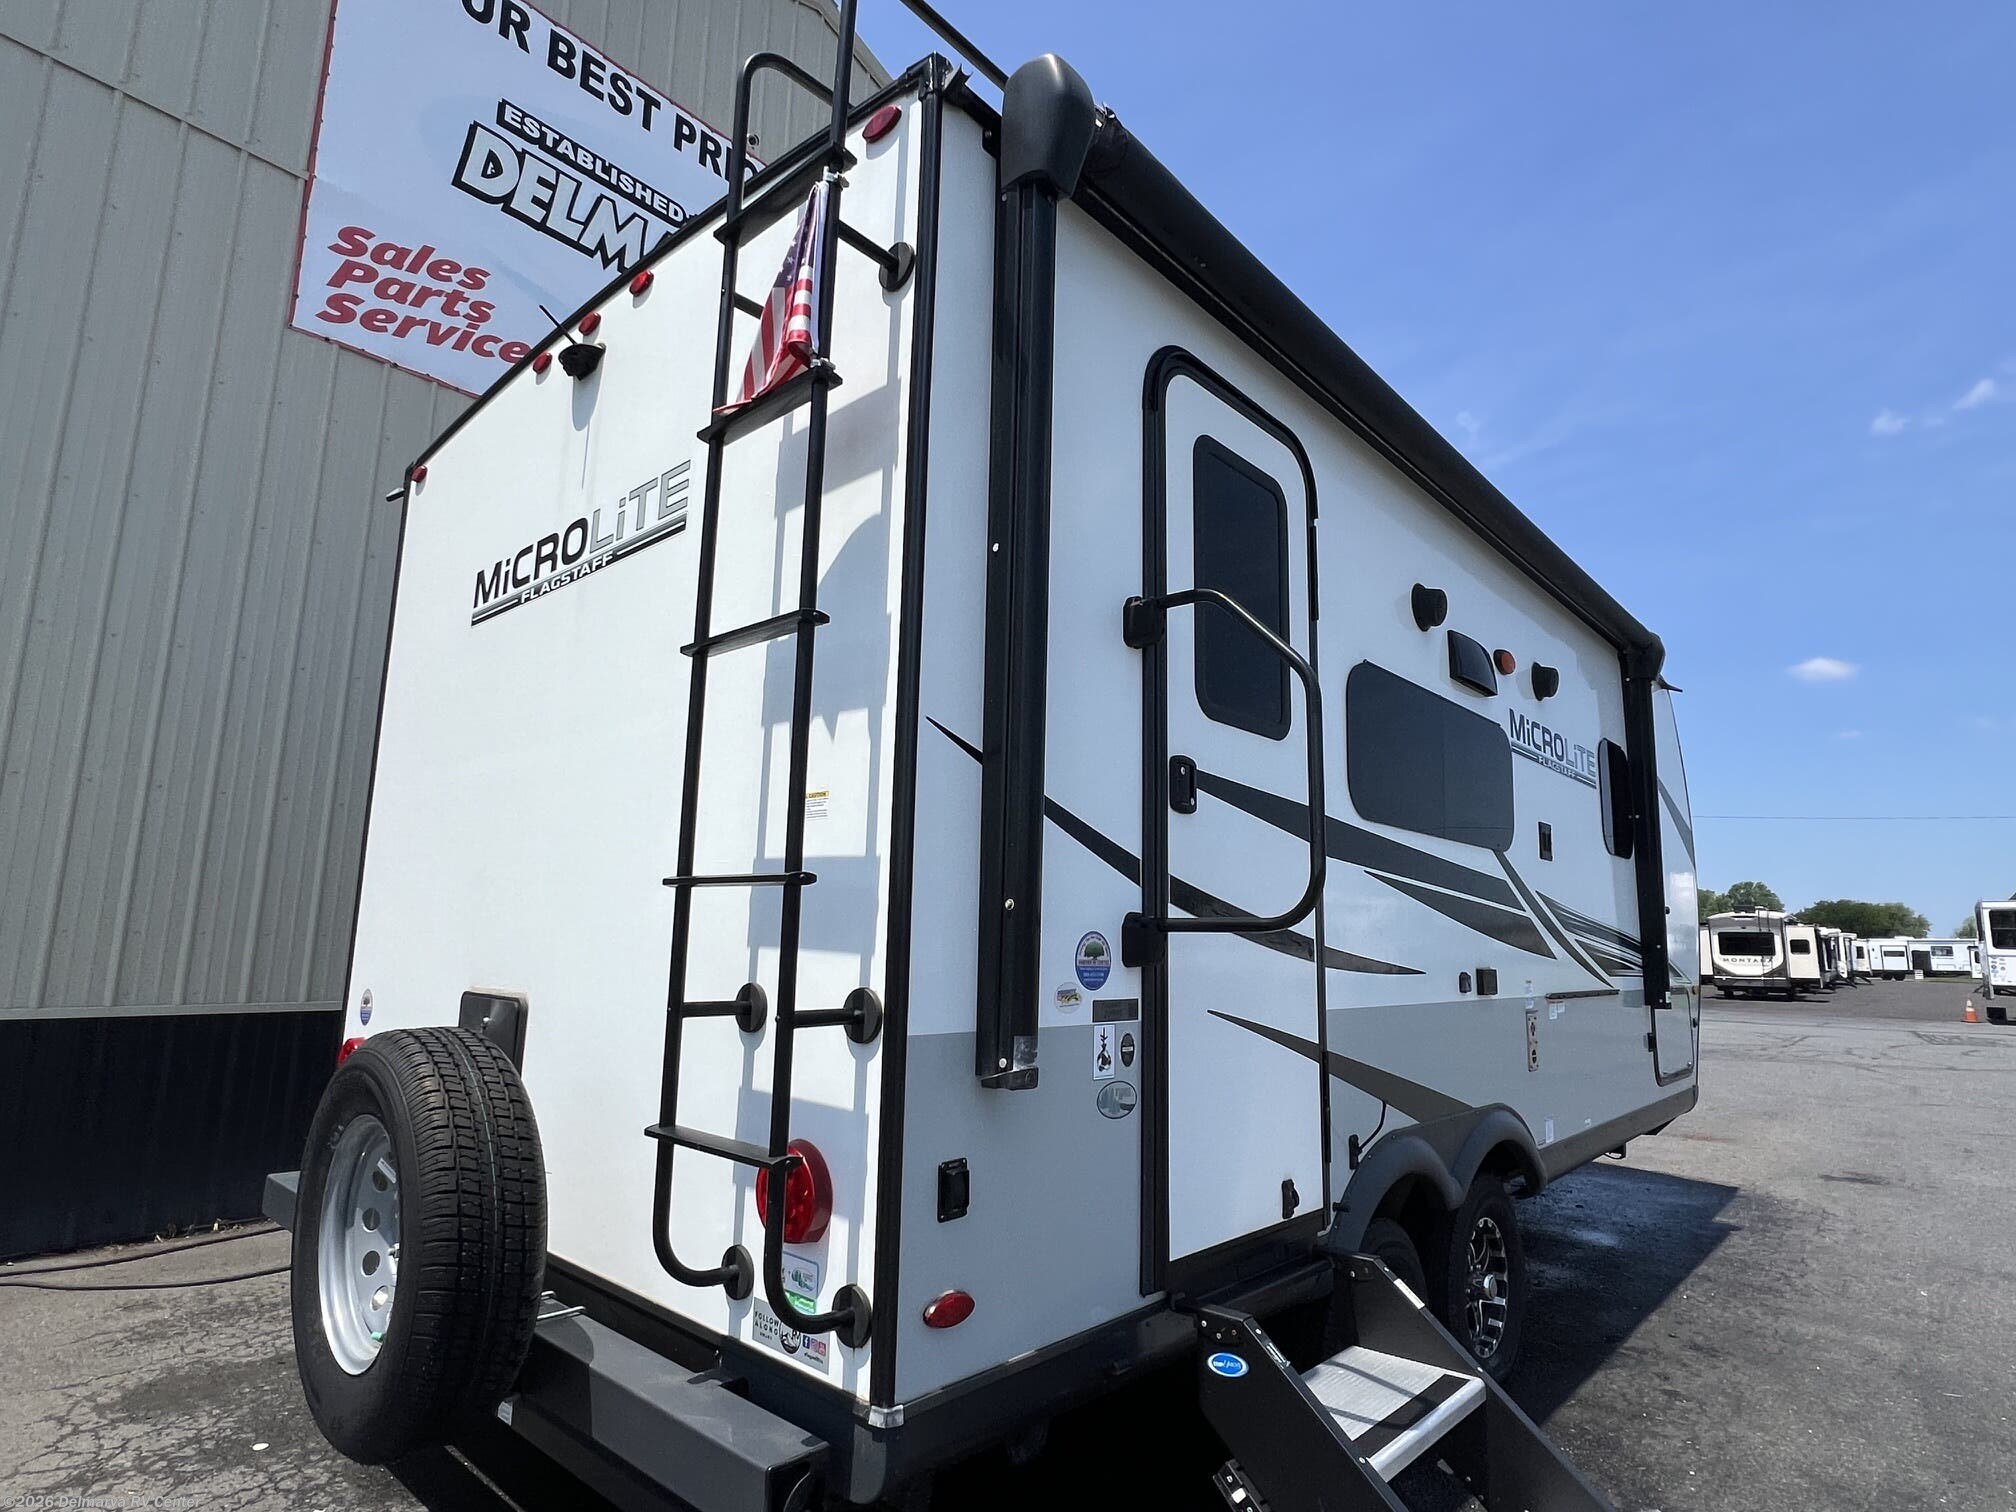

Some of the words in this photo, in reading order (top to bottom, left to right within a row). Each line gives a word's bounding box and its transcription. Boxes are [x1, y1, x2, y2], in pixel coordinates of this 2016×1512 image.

[547, 28, 661, 132] BEST
[452, 120, 672, 272] DELM
[502, 103, 686, 223] ESTABLISHED
[326, 259, 496, 323] Parts
[327, 226, 491, 290] Sales
[315, 293, 531, 363] Service
[521, 551, 614, 603] FLAGSTAFF
